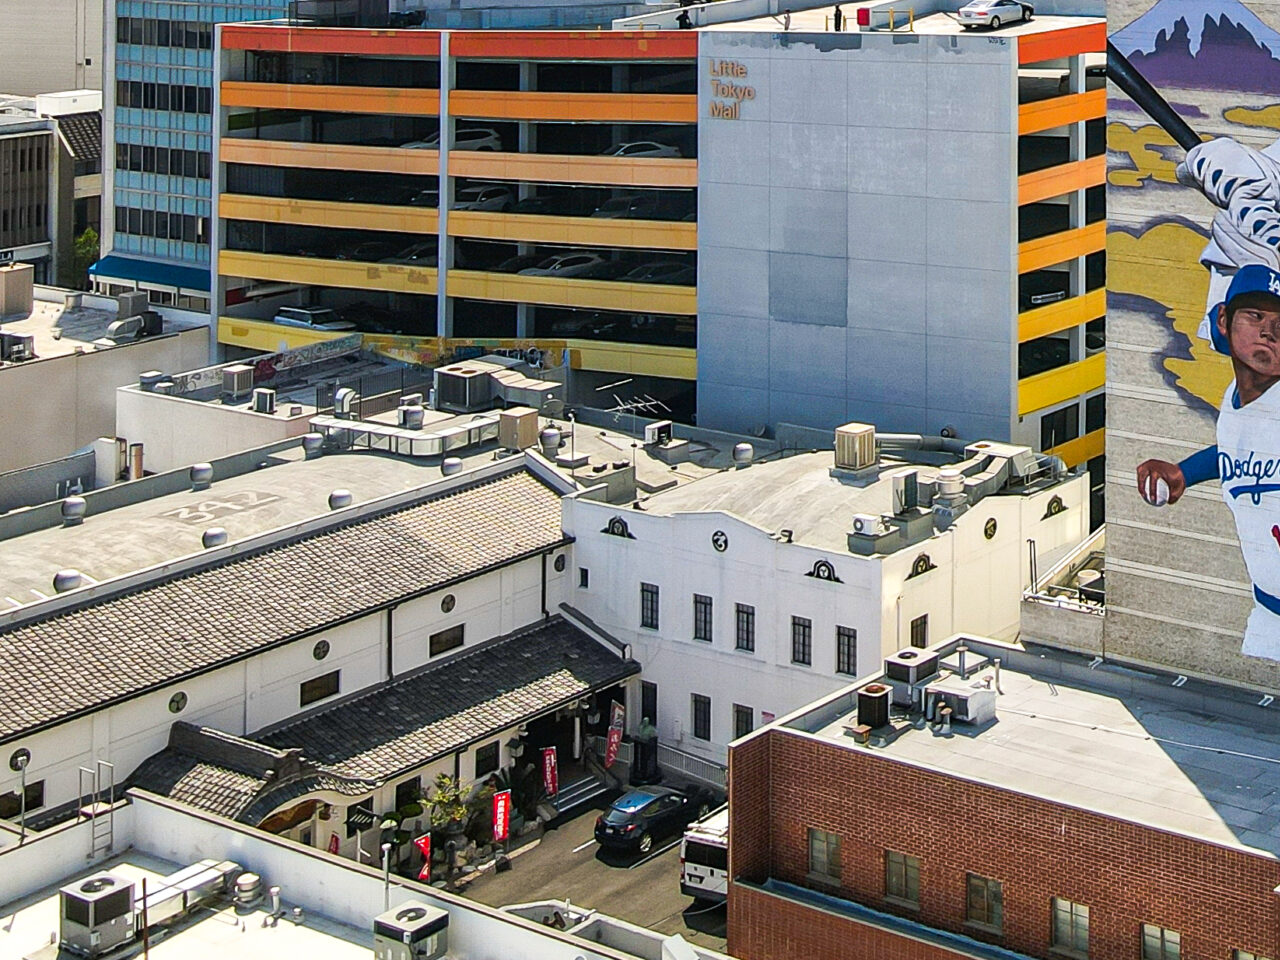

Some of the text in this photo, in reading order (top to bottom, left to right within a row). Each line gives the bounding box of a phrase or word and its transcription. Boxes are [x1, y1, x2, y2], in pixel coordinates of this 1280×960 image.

[709, 59, 747, 78] Little
[710, 80, 756, 102] Tokyo
[709, 101, 740, 120] Mall
[162, 490, 280, 524] 342
